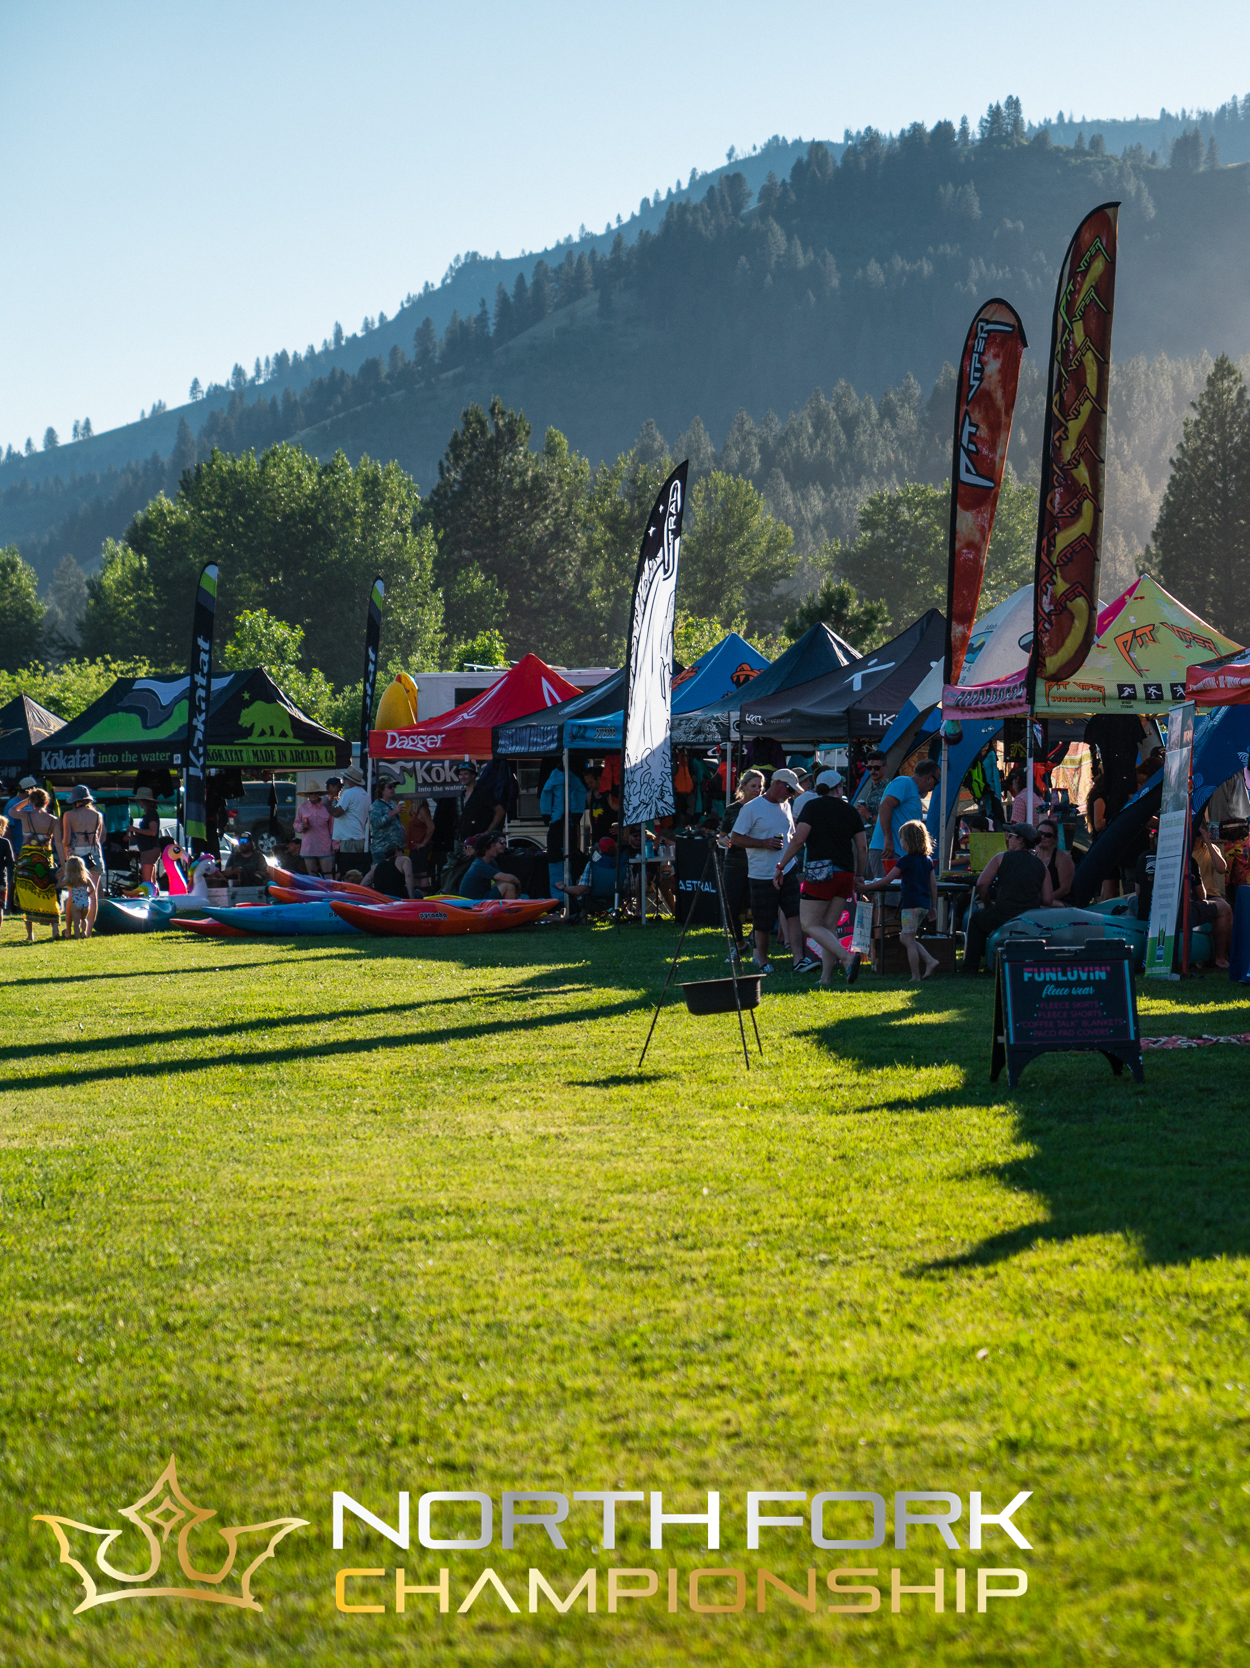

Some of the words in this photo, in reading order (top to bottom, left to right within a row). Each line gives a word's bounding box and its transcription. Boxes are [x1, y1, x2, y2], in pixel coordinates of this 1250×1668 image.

[1075, 235, 1115, 274] VIPER
[1070, 285, 1111, 322] VIPER
[966, 318, 1016, 407] VIPER
[1066, 335, 1109, 373] VIPER
[1065, 385, 1107, 422] VIPER
[1062, 434, 1105, 470] VIPER
[1055, 483, 1102, 519] VIPER
[1054, 532, 1099, 567] VIPER
[1048, 581, 1096, 616] VIPER
[1114, 623, 1156, 678] PIT
[1159, 622, 1221, 658] VIPER
[98, 752, 118, 764] into
[121, 751, 138, 763] the
[140, 751, 171, 762] water
[251, 749, 276, 763] MADE
[277, 749, 287, 763] IN
[289, 749, 323, 764] ARCATA,
[325, 749, 334, 763] CA
[385, 731, 446, 753] Dagger
[1023, 966, 1110, 982] FUNLUVIN'
[1042, 984, 1070, 998] fleece
[1071, 986, 1095, 996] wear
[1040, 1001, 1070, 1009] FLEECE
[1072, 1001, 1099, 1009] SKIRTS
[1070, 1010, 1102, 1018] SHORTS
[1081, 1018, 1123, 1027] BLANKETS
[1058, 1029, 1075, 1037] PAD
[1076, 1028, 1110, 1037] COVERS
